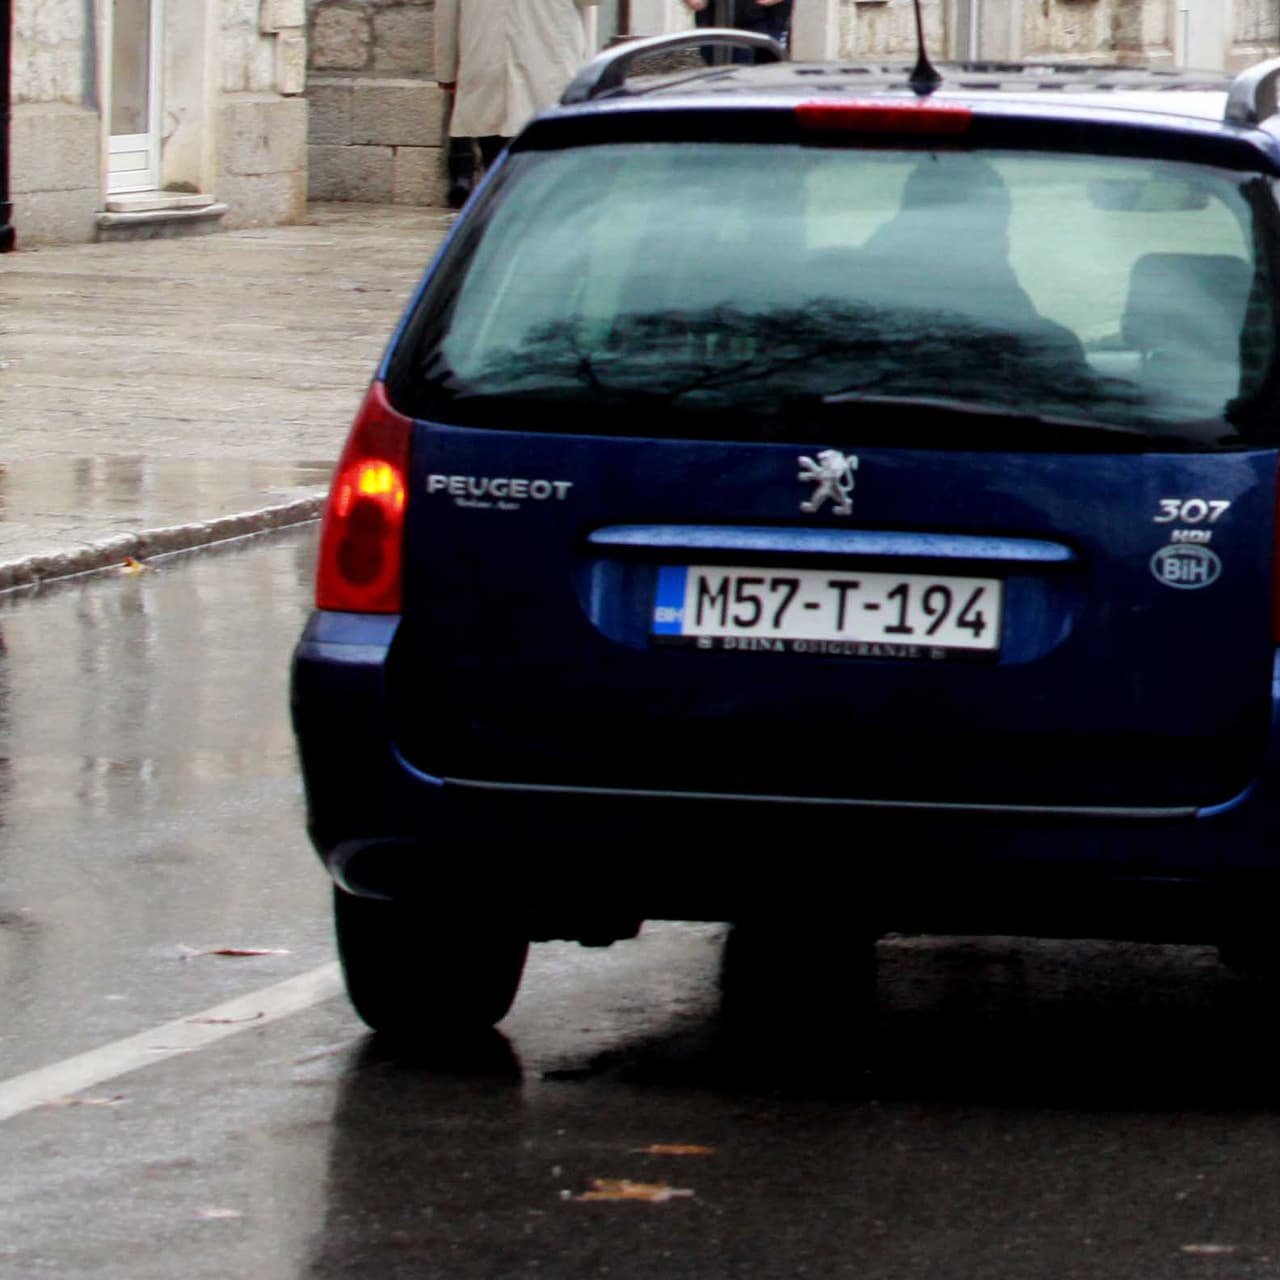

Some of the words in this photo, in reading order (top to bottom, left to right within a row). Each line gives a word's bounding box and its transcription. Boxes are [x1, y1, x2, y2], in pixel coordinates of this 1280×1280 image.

[426, 474, 573, 501] PEUGEOT
[1152, 498, 1231, 523] 307
[1163, 557, 1209, 582] BiH
[694, 576, 988, 639] M57-T-194
[792, 638, 921, 659] OSIGURANJE
